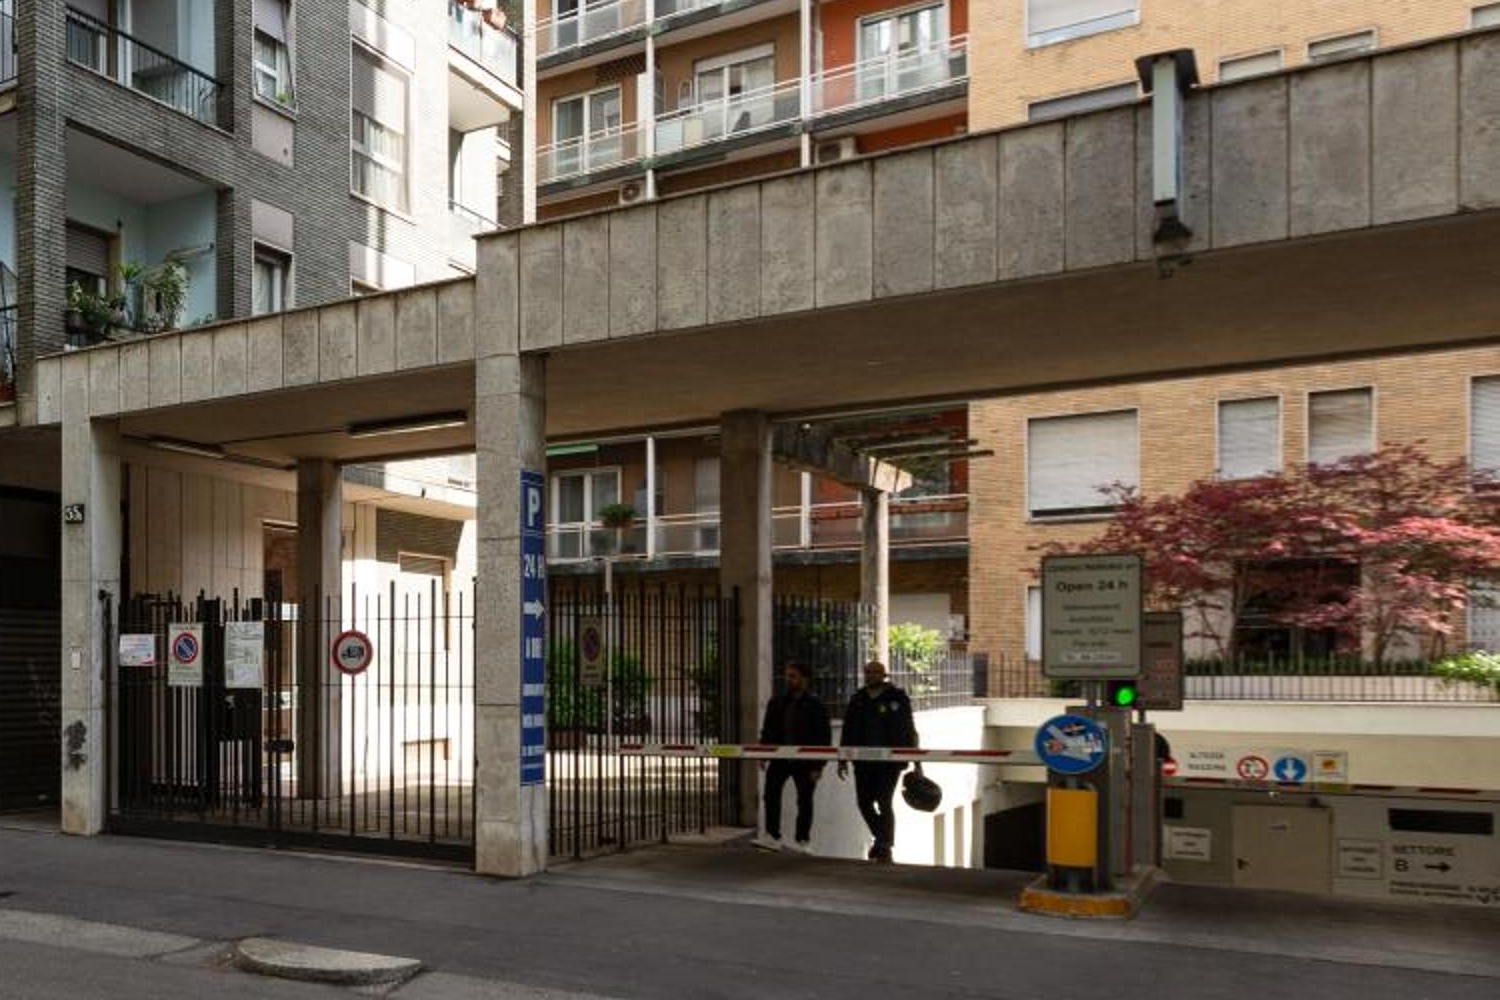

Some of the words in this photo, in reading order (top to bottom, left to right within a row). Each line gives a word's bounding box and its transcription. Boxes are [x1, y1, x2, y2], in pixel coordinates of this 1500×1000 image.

[527, 487, 541, 527] P
[523, 553, 535, 579] 24
[1055, 581, 1093, 593] Open
[1097, 580, 1114, 591] 24
[1395, 859, 1409, 872] B
